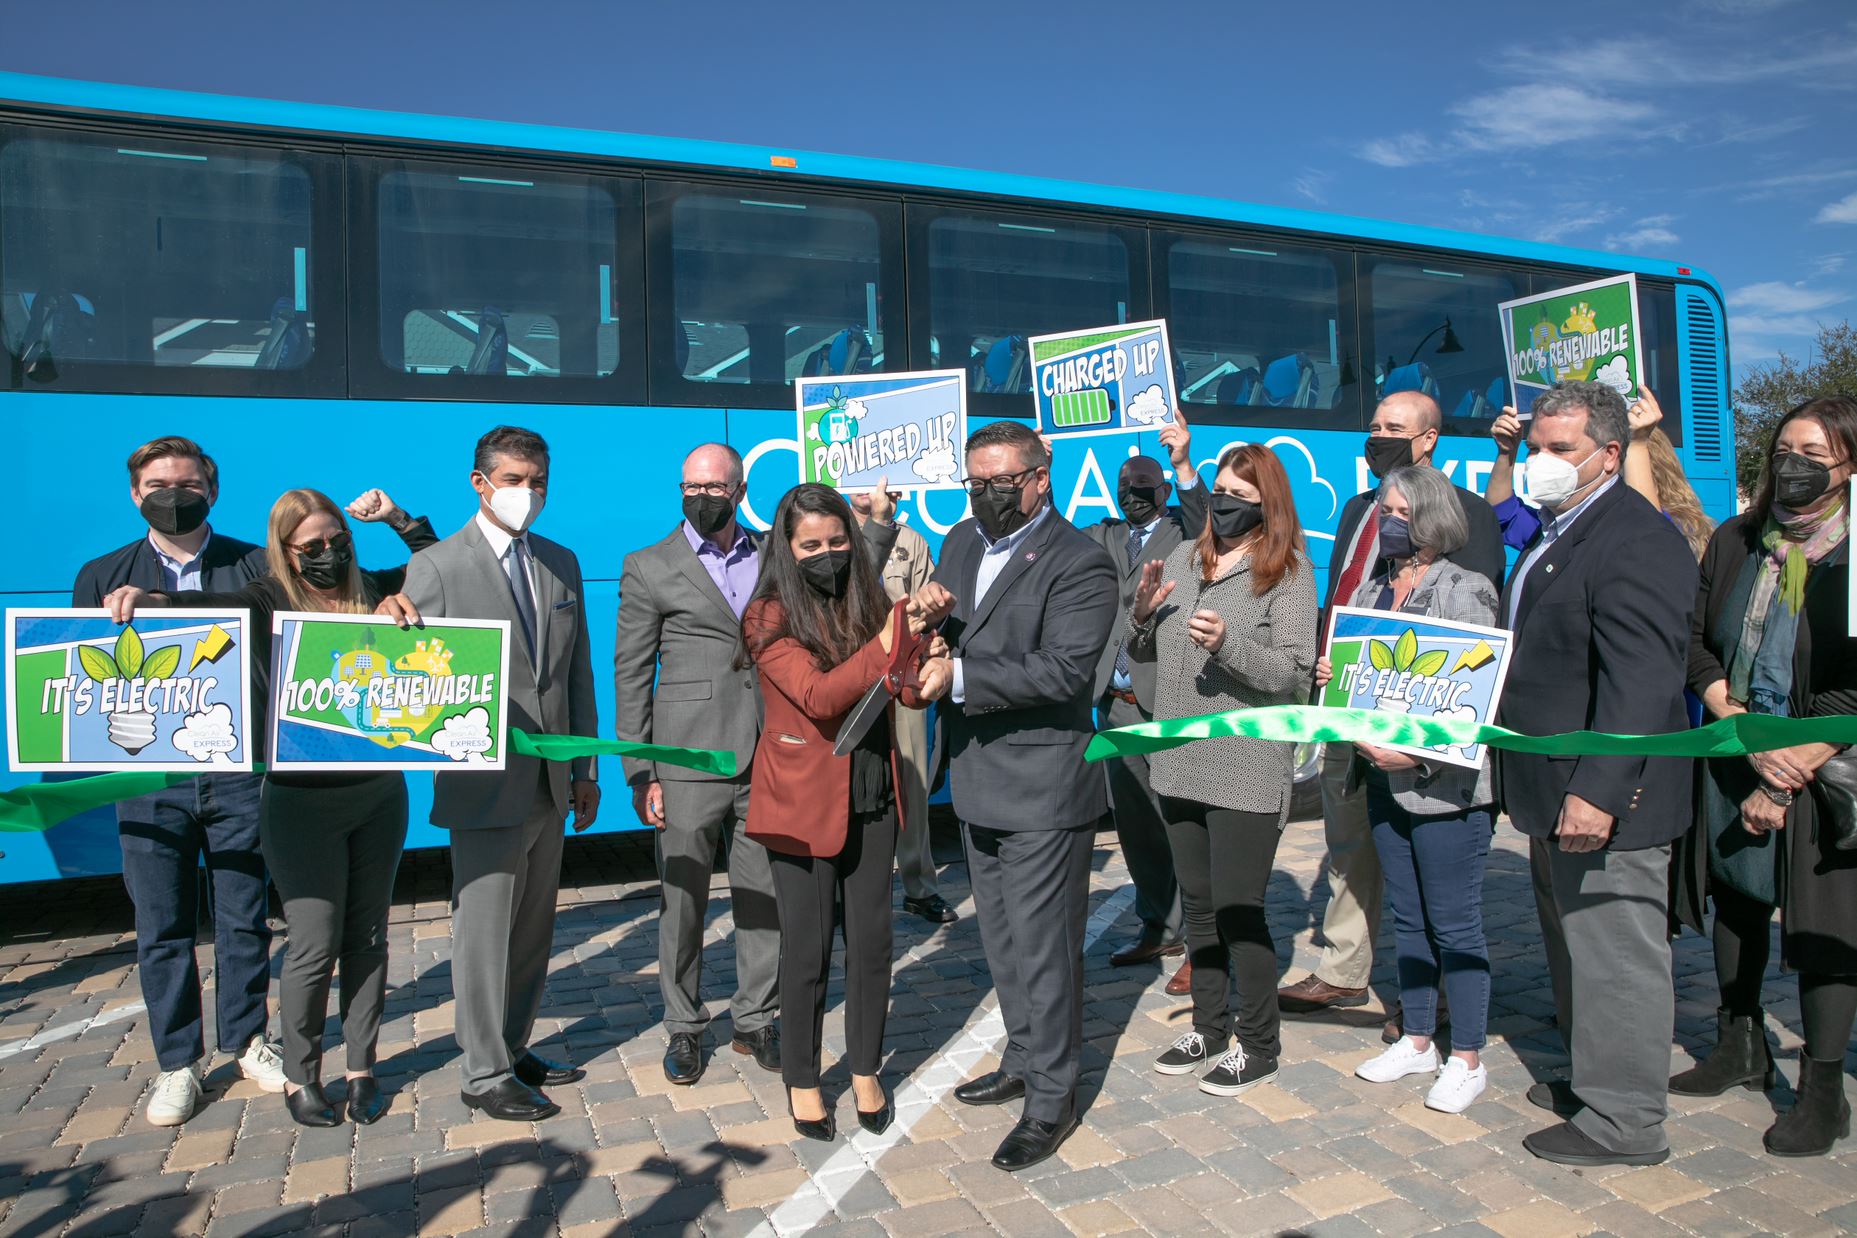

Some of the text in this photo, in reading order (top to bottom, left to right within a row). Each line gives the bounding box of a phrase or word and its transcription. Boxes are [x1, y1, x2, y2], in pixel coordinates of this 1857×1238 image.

[1042, 339, 1160, 397] CHARGED UP
[1513, 323, 1629, 377] 100% RENEWABLE
[813, 411, 957, 483] POWERED UP
[41, 673, 219, 715] IT'S ELECTRIC
[287, 672, 495, 713] 100% RENEWABLE
[1337, 661, 1473, 712] IT'S ELECTRIC
[193, 739, 232, 748] EXPRESS
[450, 739, 487, 748] EXPRESS
